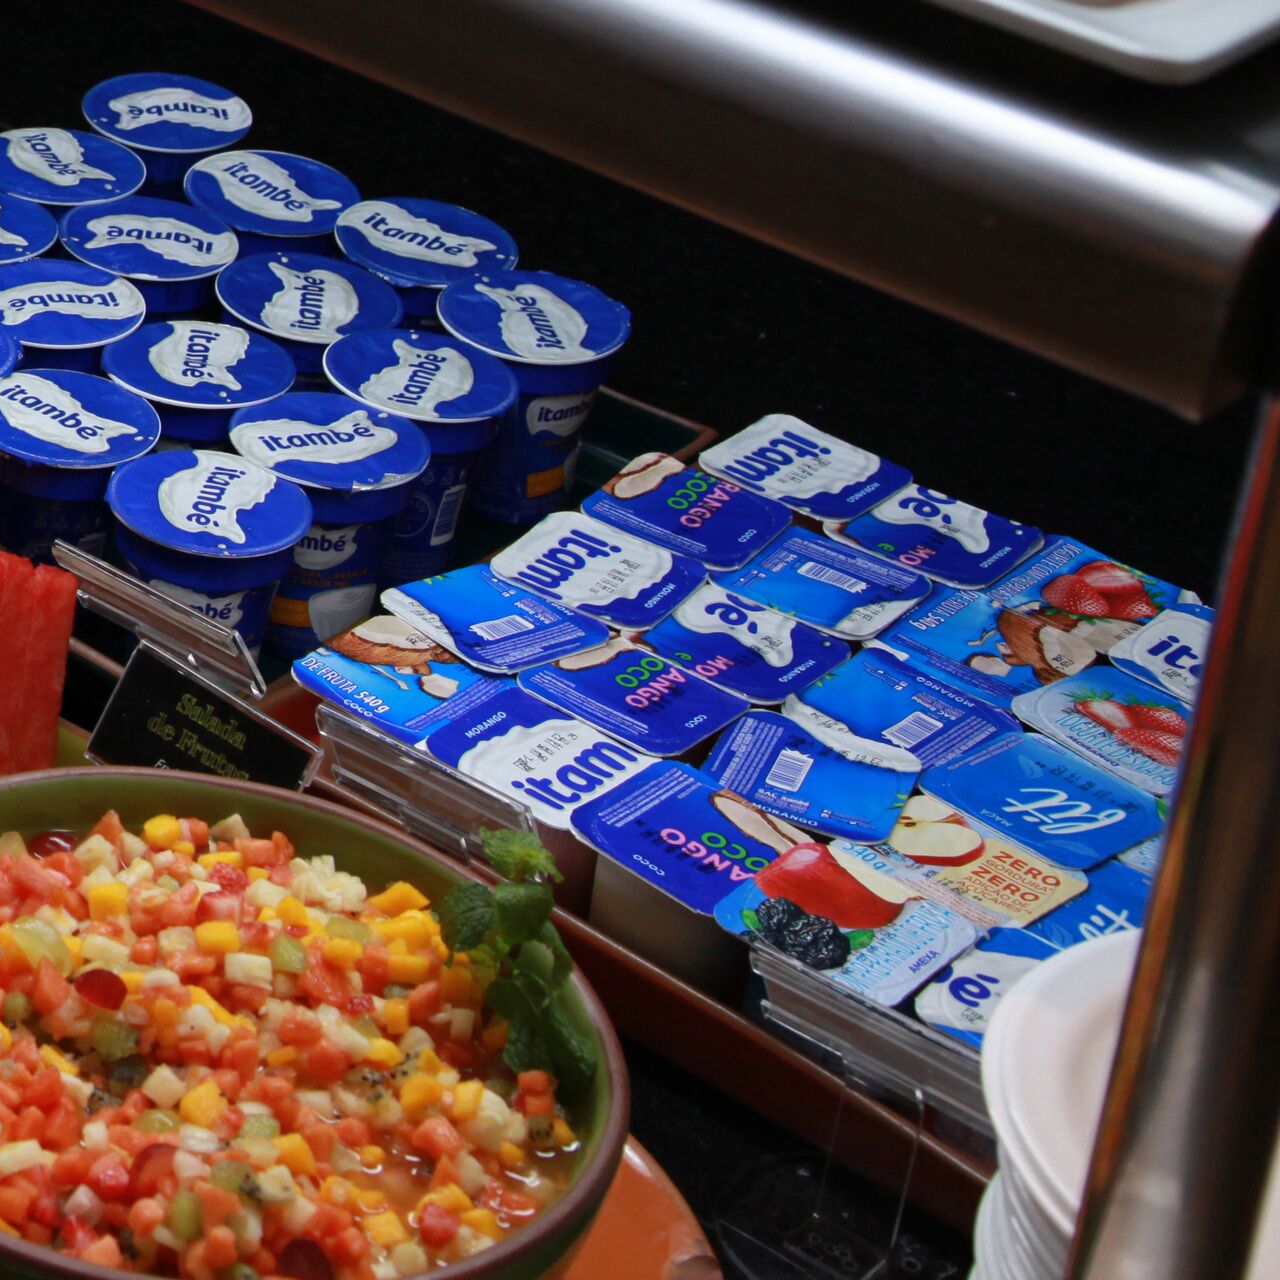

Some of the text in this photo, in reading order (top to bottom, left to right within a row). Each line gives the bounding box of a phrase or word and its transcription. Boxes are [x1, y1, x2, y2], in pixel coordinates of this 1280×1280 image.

[127, 102, 231, 123] itambé
[25, 132, 81, 176] itambé
[223, 161, 308, 212] itambé
[105, 224, 215, 256] itambé
[364, 211, 468, 257] itambé
[7, 289, 119, 312] itambé
[289, 274, 327, 331] itambé
[515, 295, 554, 350] itambé
[181, 327, 213, 380] itambé
[385, 351, 447, 407] itambé
[258, 422, 377, 454] itambé
[184, 464, 237, 530] itambé
[846, 481, 881, 504] MORANGO
[737, 528, 758, 544] COCO
[644, 583, 677, 609] MORANGO
[301, 657, 324, 672] DE
[316, 665, 358, 694] FRUTA
[778, 659, 816, 684] MORANGO
[343, 698, 374, 718] COCO
[915, 676, 976, 708] MORANGO
[147, 712, 175, 742] de
[175, 692, 247, 751] Salada
[463, 710, 507, 739] MORANGO
[684, 714, 708, 728] COCO
[1067, 734, 1120, 767] MORANGO
[751, 801, 819, 827] MORANGO
[632, 853, 666, 877] COCO
[991, 850, 1062, 888] ZERO
[970, 868, 1040, 903] ZERO
